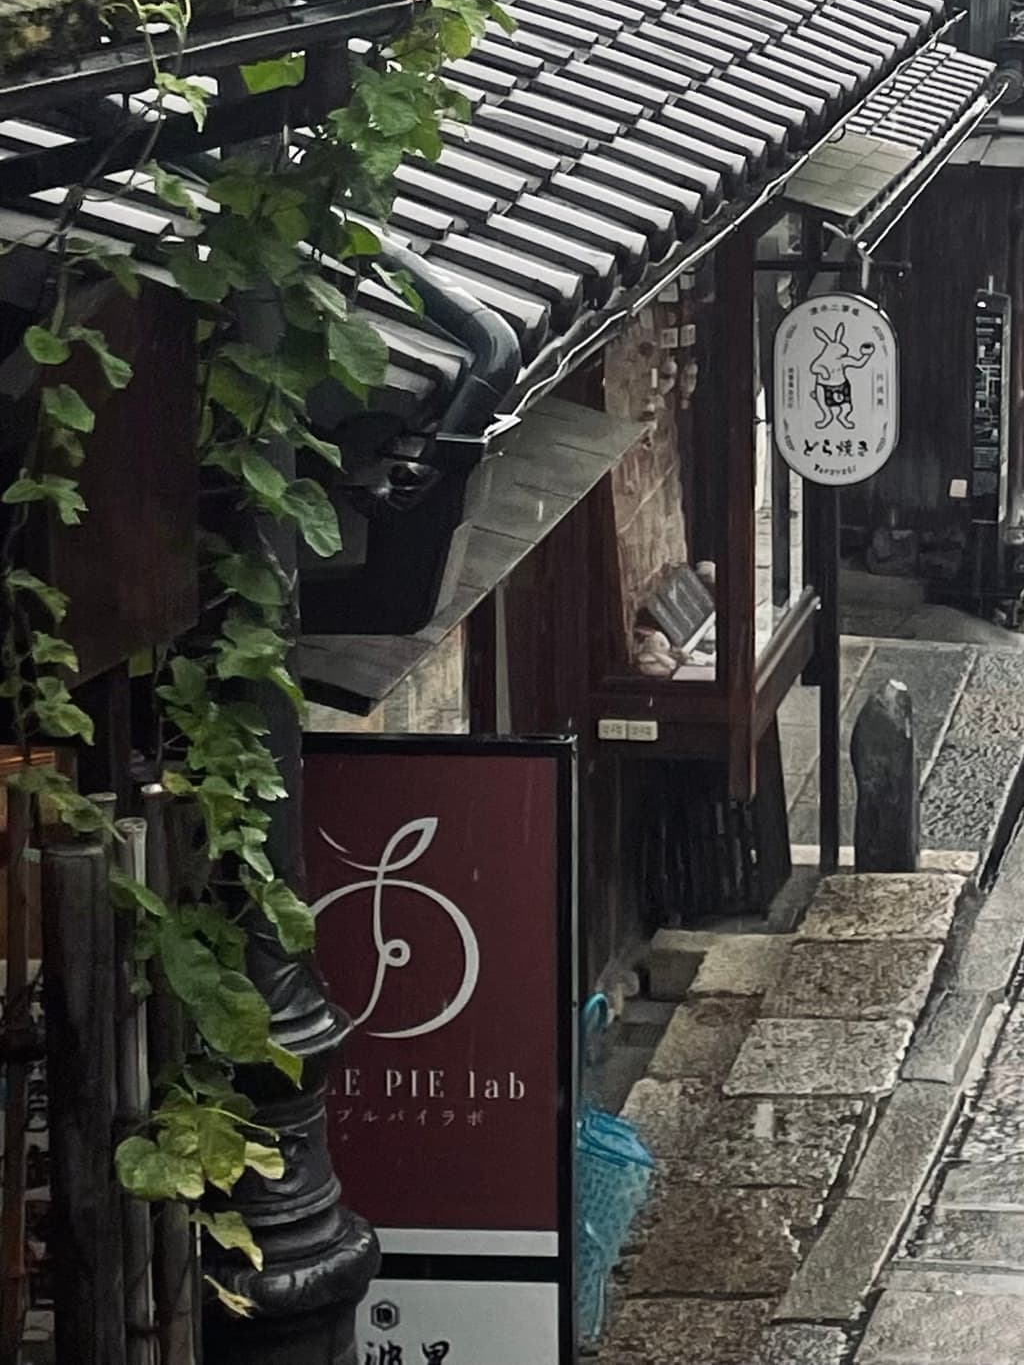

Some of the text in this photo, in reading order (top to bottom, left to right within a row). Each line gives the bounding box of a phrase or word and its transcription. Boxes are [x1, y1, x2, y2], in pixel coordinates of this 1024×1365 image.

[803, 438, 868, 457] どら焼き
[386, 1068, 445, 1098] PIE
[468, 1070, 526, 1100] lab
